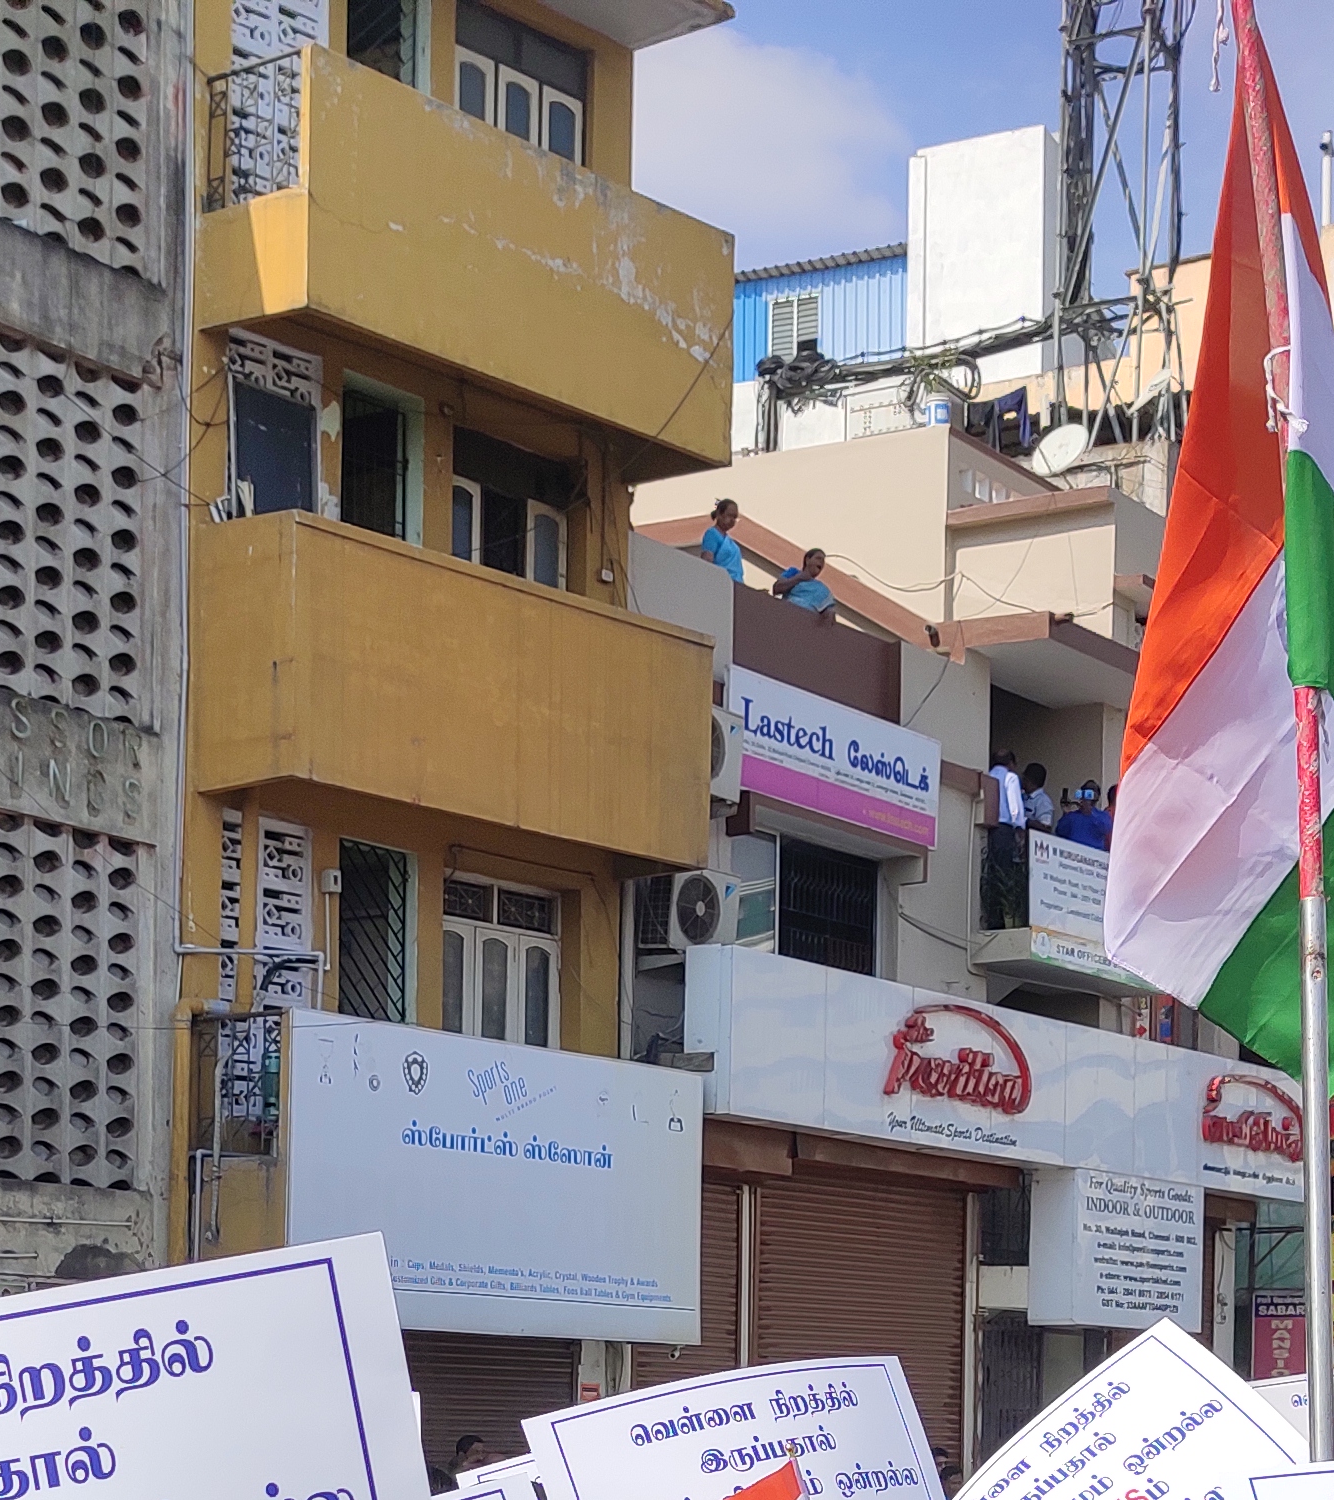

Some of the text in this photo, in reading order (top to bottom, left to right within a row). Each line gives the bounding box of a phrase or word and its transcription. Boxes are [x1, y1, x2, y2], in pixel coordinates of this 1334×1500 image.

[740, 695, 835, 762] Lastech
[847, 740, 929, 792] லேஸ்டெக்
[1057, 944, 1075, 957] STAR
[467, 1060, 510, 1106] Sports
[503, 1077, 528, 1105] one
[402, 1119, 518, 1158] ஸ்போர்ட்ஸ்
[910, 1115, 1017, 1147] Ultimate Sports Destination
[1089, 1175, 1194, 1203] For Quality Sports Goods:
[1086, 1196, 1195, 1225] INDOOR OUTDOOR
[636, 1278, 658, 1288] Awards
[629, 1381, 860, 1447] வெள்ளை நிறத்தில்
[1039, 1381, 1131, 1457] நிறத்தில்
[1123, 1399, 1224, 1476] ஒன்றல்ல
[834, 1460, 920, 1499] ஒன்றல்ல
